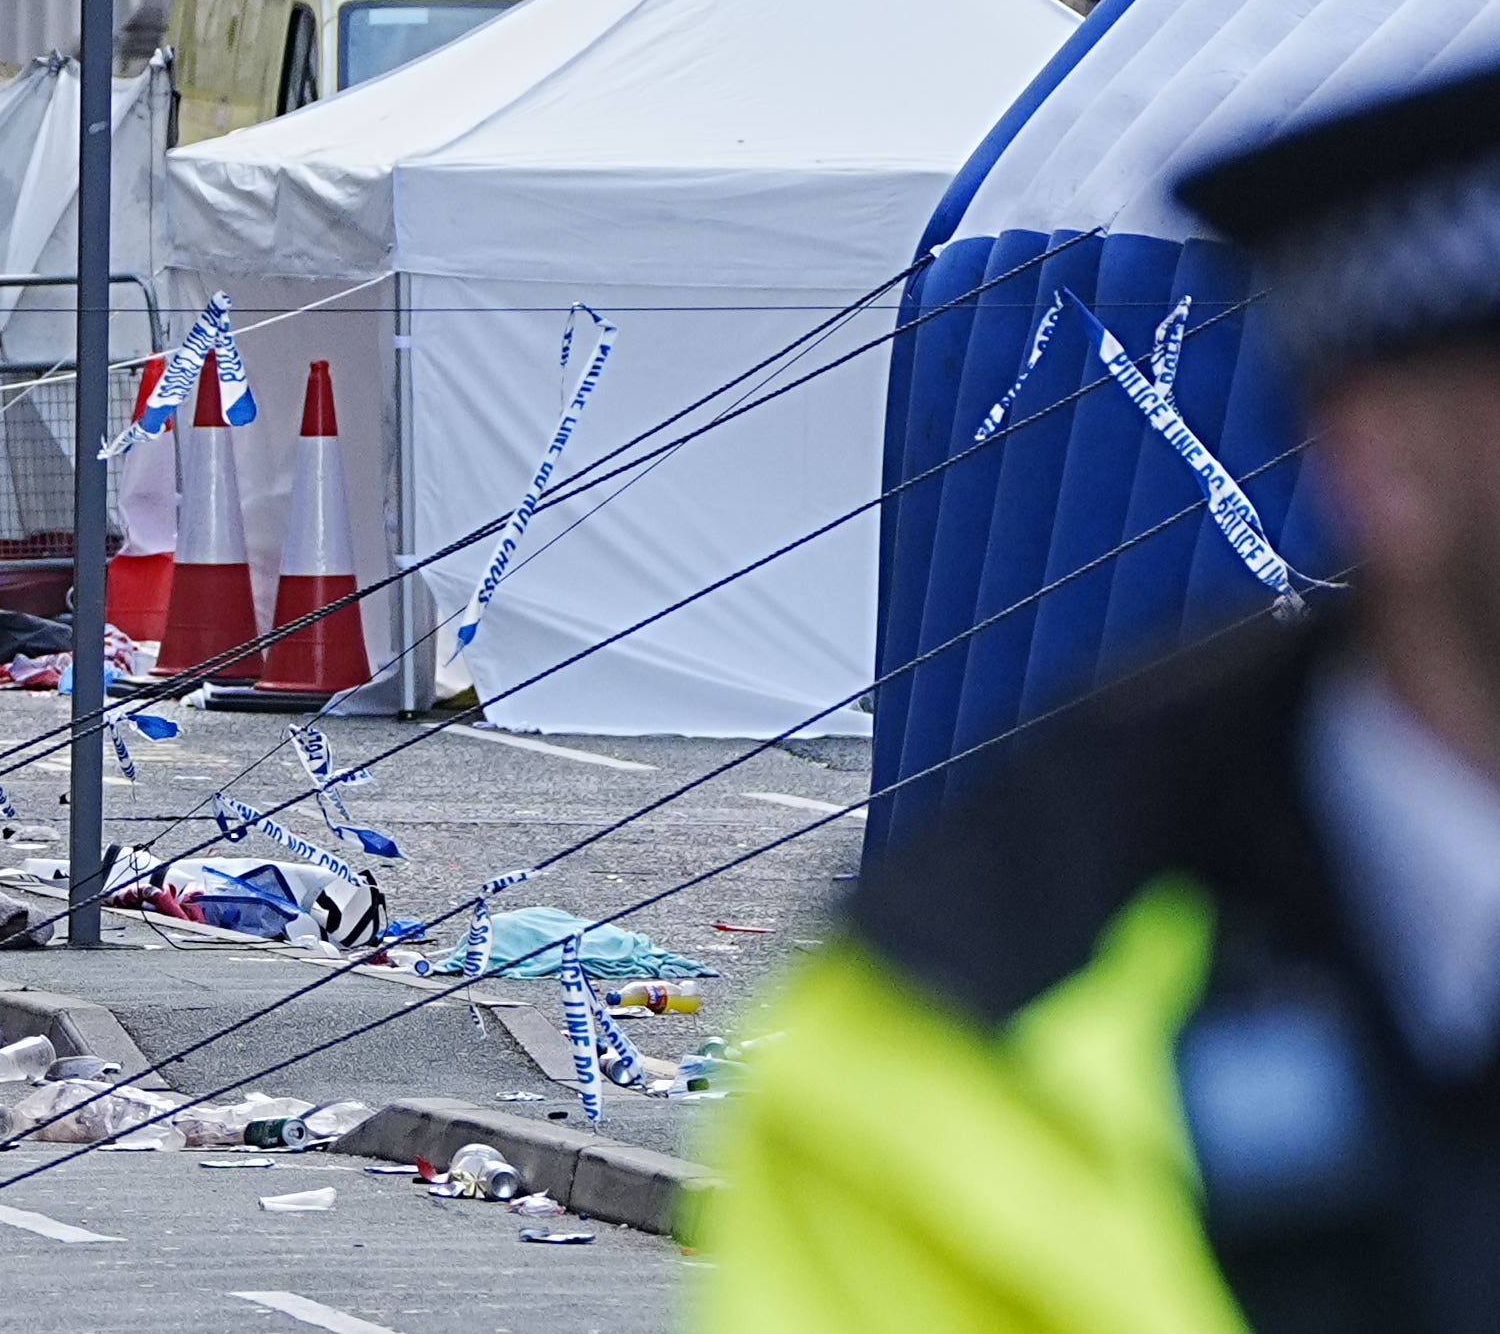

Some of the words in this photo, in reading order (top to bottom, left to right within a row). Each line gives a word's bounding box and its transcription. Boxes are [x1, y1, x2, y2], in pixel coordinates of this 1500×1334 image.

[1107, 351, 1170, 429] POLICE
[1163, 420, 1202, 464] LINE
[562, 1000, 591, 1047] LINE
[573, 1054, 596, 1085] DO
